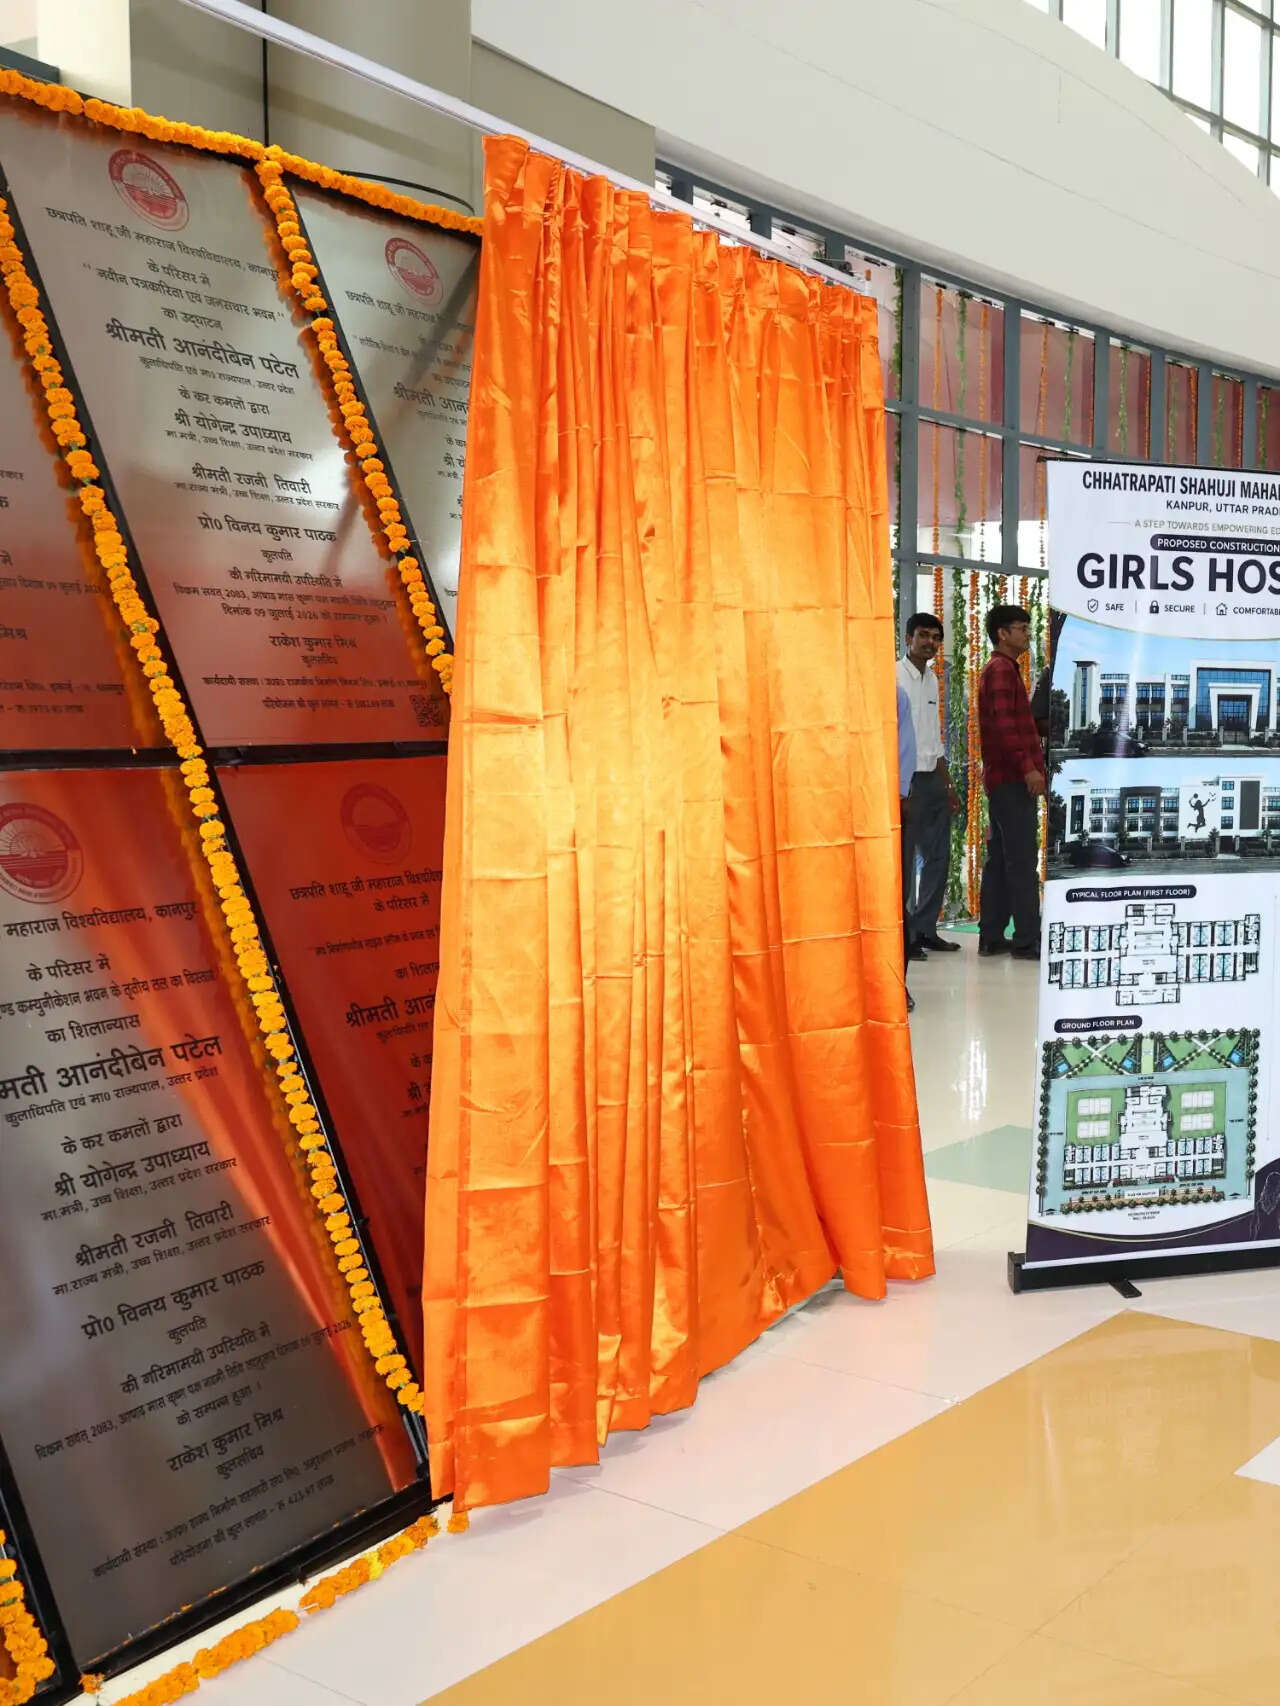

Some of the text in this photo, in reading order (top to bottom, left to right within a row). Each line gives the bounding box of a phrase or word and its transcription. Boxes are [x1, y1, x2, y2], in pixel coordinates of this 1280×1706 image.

[106, 317, 300, 379] श्रीमती आनंदीबेन पटेल
[393, 381, 436, 408] श्रीमती
[174, 408, 190, 427] श्री
[193, 413, 237, 436] योगेन्द्र
[192, 463, 311, 495] श्रीमती रजनी तिवारी
[1083, 470, 1176, 494] CHHATRAPATI
[1180, 476, 1235, 498] SHAHUJI
[1166, 500, 1212, 513] KANPUR,
[1215, 503, 1249, 515] UTTAR
[225, 515, 338, 542] विनय कुमार पाठक
[1143, 520, 1165, 528] STEP
[1168, 520, 1209, 531] TOWARDS
[1211, 523, 1269, 535] EMPOWERING
[1157, 538, 1207, 549] PROPOSED
[1209, 541, 1280, 553] CONSTRUCTION
[1077, 552, 1194, 591] GIRLS
[1105, 603, 1124, 611] SAFE
[1164, 604, 1195, 613] SECURE
[289, 881, 325, 900] छत्रपति
[368, 875, 404, 890] महाराज
[1072, 888, 1191, 899] TYPICAL FLOOR PLAN (FIRST FLOOR)
[3, 916, 60, 938] महाराज
[154, 902, 200, 921] कानपुर
[26, 962, 42, 983] के
[46, 959, 94, 980] परिसर
[84, 988, 110, 1003] भवन
[345, 995, 400, 1029] श्रीमती
[1061, 1019, 1135, 1030] GROUND FLOOR PLAN
[45, 1014, 142, 1044] का शिलान्यास
[56, 1033, 223, 1088] आनंदीबेन पटेल
[5, 1101, 67, 1128] कुलाधिपति
[61, 1135, 78, 1156] के
[80, 1132, 104, 1151] कर
[153, 1113, 183, 1134] द्वारा
[54, 1140, 211, 1198] श्री योगेन्द्र उपाध्याय
[205, 1157, 239, 1176] सरकार
[74, 1200, 235, 1268] श्रीमती रजनी तिवारी
[117, 1260, 265, 1326] विनय कुमार पाठक
[167, 1315, 208, 1344] कुलपति
[121, 1374, 140, 1395] की
[141, 1350, 206, 1387] गरिमामयी
[166, 1407, 285, 1472] राकेश कुमार मिश्र
